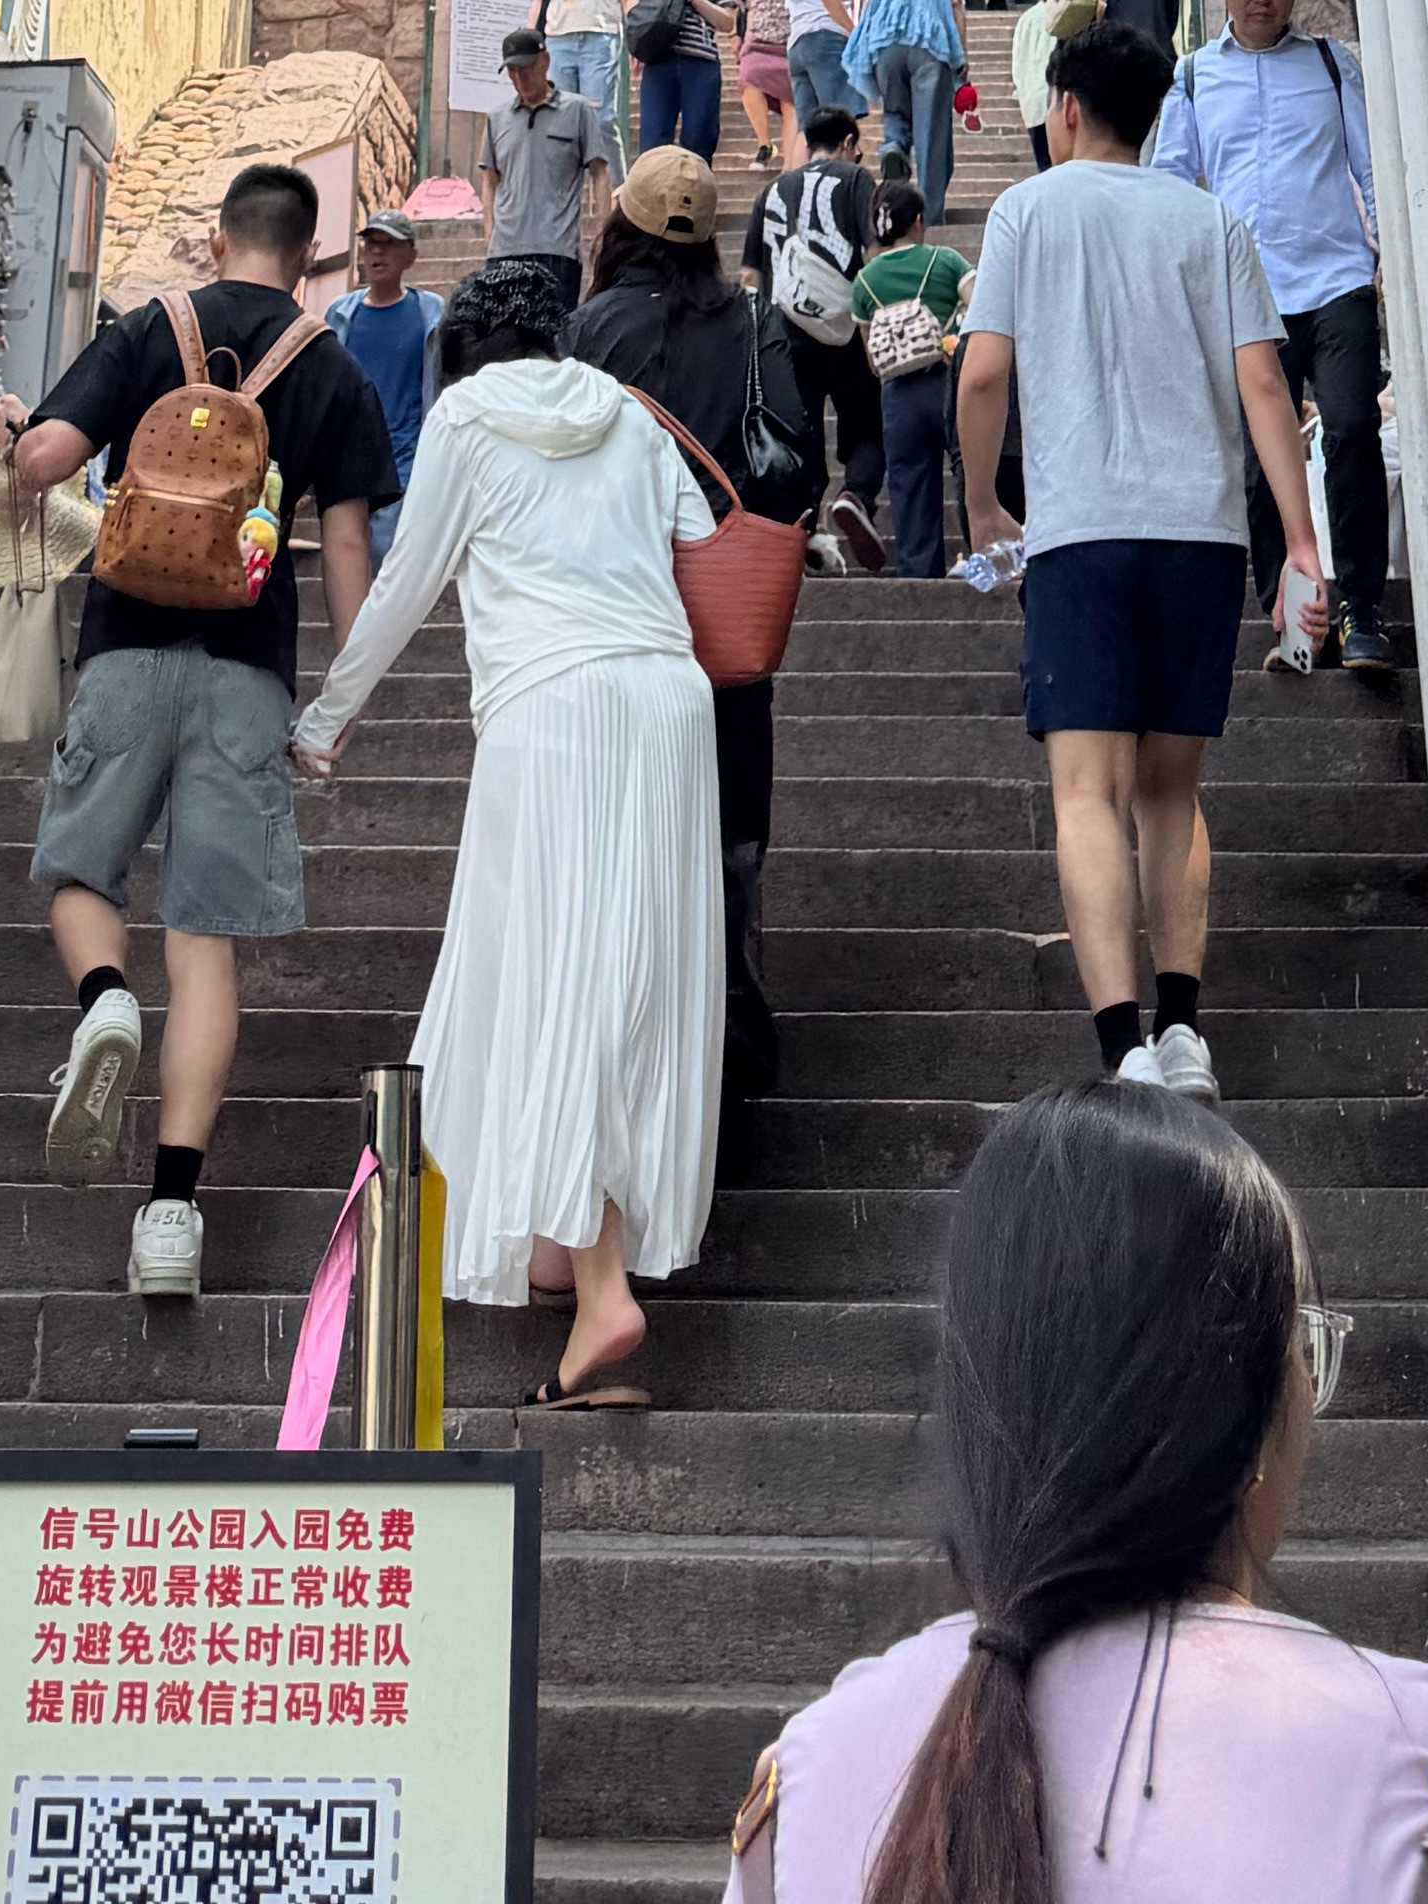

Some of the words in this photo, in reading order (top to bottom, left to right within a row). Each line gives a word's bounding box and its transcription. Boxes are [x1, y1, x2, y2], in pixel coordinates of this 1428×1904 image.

[38, 1506, 417, 1552] 信号山公园入园免费
[32, 1563, 415, 1611] 旋转观景楼正常收费
[30, 1621, 412, 1668] 为避免您长时间排队
[24, 1678, 411, 1727] 提前用微信扫码购票
